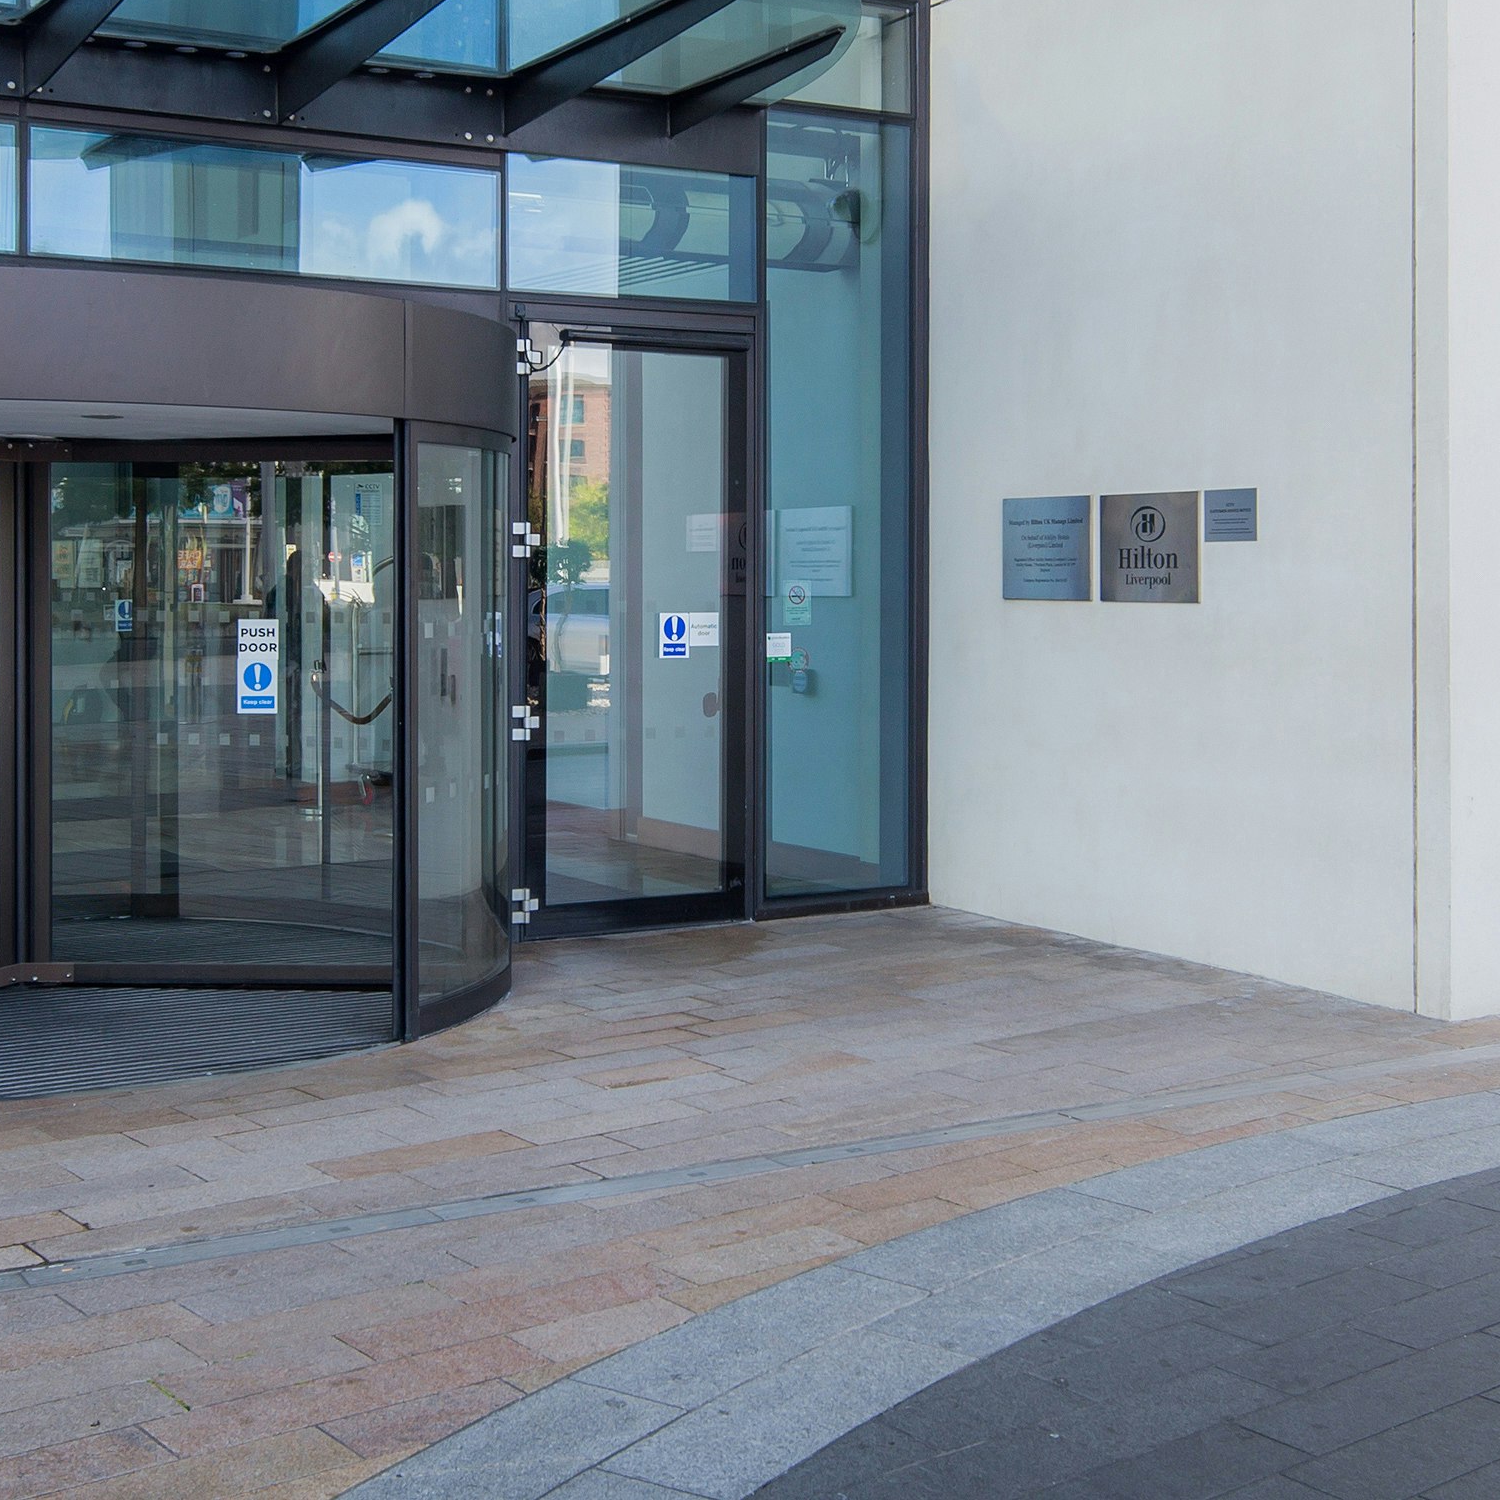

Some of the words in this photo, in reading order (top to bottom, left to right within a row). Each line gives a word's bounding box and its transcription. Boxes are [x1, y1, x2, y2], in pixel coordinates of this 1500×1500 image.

[1118, 545, 1179, 569] Hilton
[1125, 572, 1171, 589] Liverpool
[241, 627, 275, 637] PUSH
[239, 643, 277, 652] DOOR
